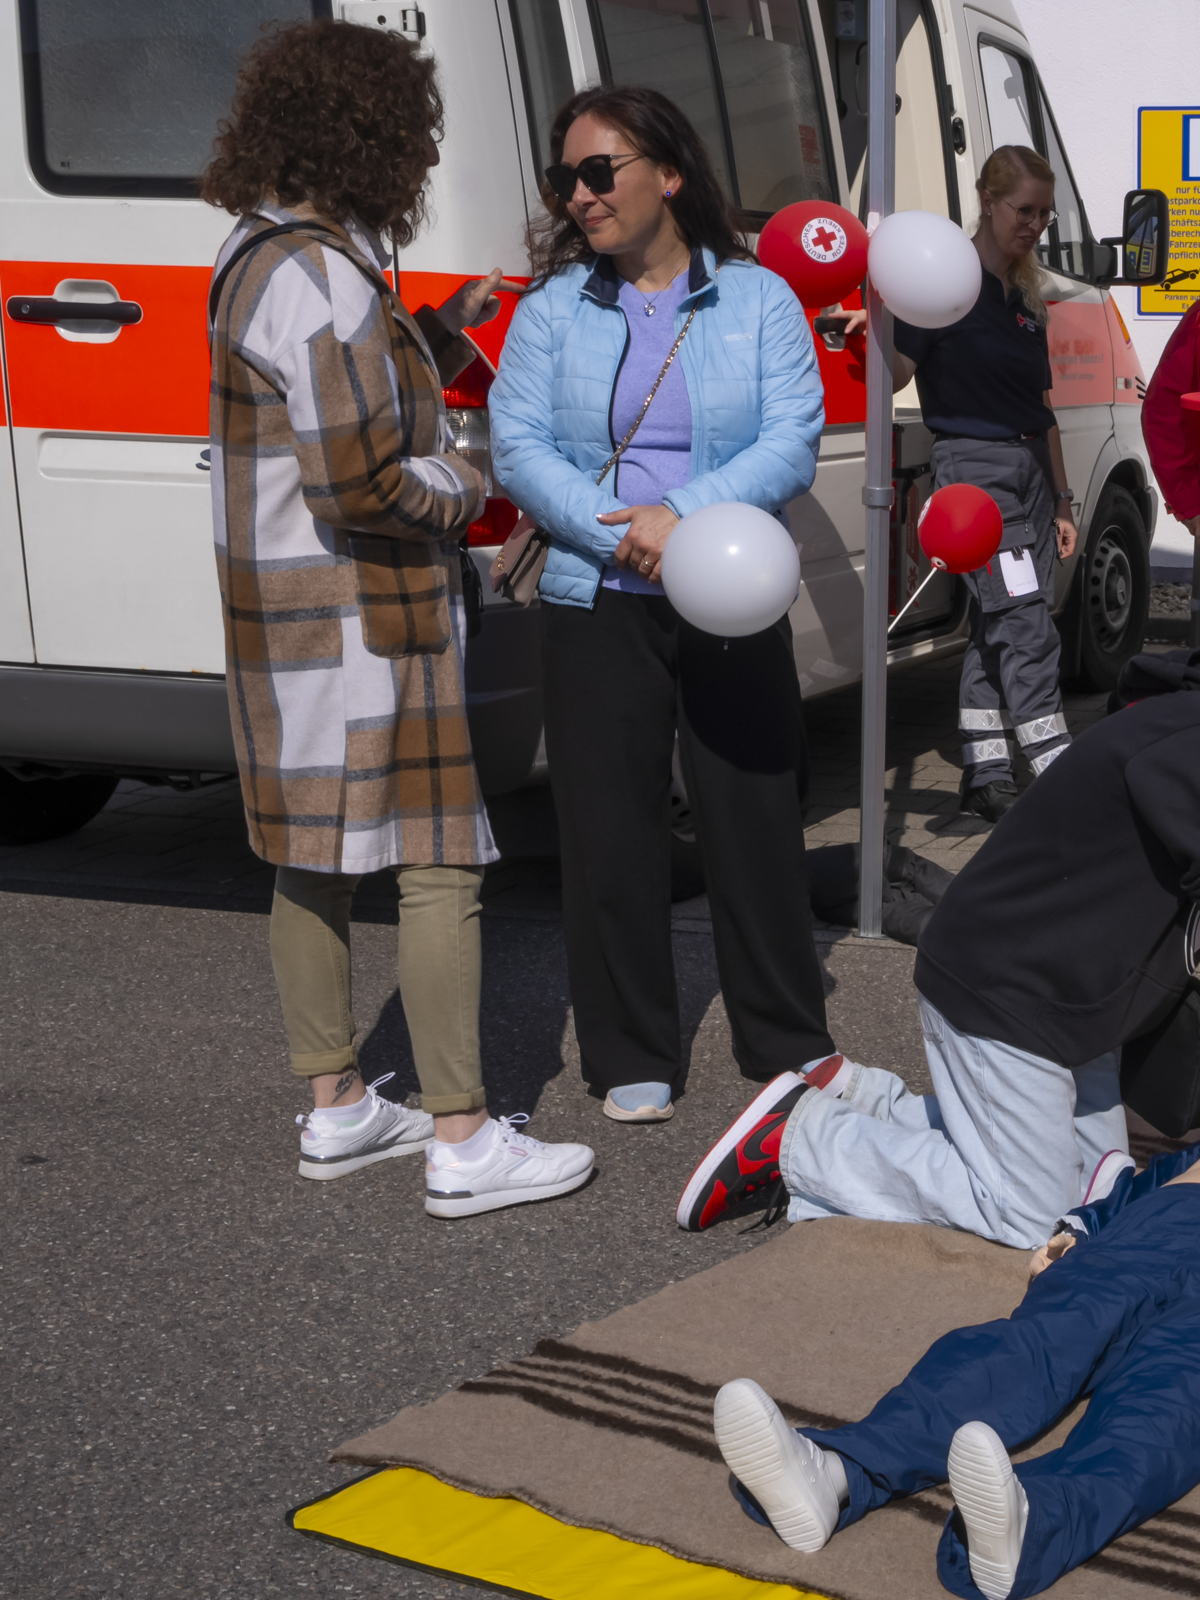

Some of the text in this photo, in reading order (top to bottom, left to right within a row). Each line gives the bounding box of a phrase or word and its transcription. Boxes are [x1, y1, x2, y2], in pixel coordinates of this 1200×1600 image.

[803, 218, 845, 260] DEUTSCHES ROTES KREUZ
